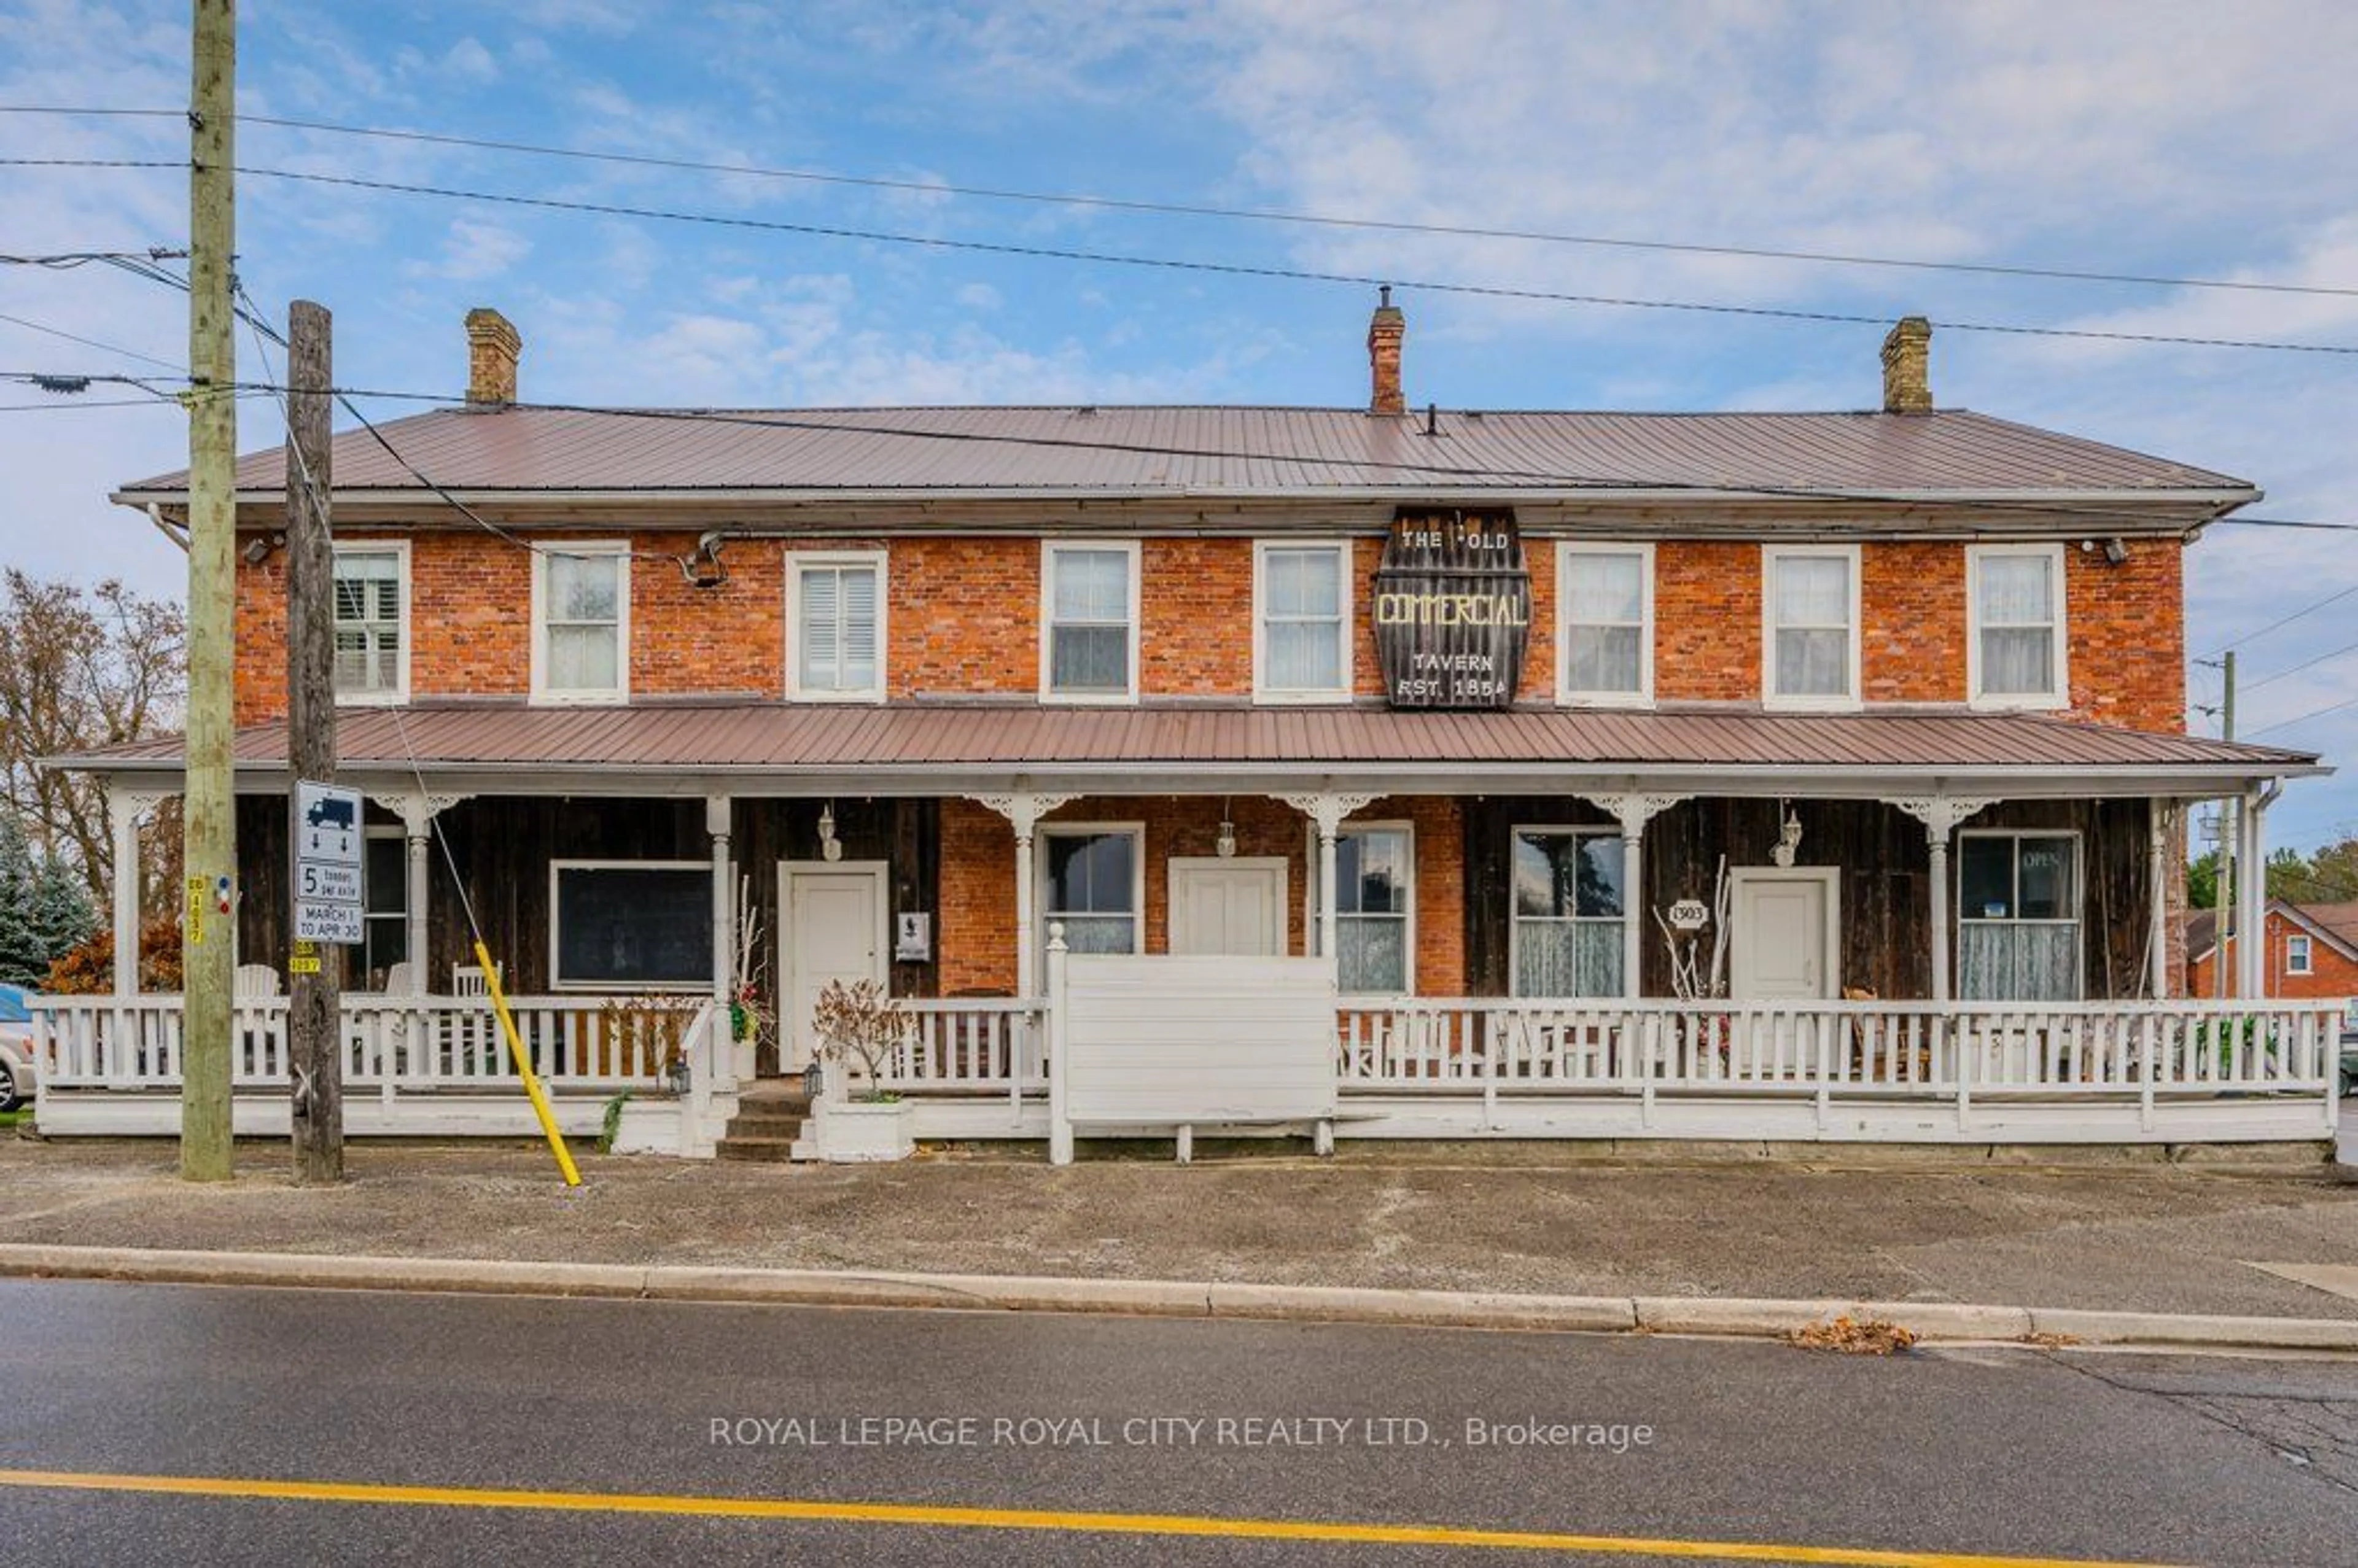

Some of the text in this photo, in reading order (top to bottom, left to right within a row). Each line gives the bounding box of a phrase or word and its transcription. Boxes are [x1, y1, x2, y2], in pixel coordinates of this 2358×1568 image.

[1403, 531, 1508, 549] THE OLD
[1379, 594, 1528, 626] COMMERCIAL
[1414, 654, 1493, 671] TAVERN
[305, 867, 317, 894] 5
[306, 907, 346, 922] MARCH
[301, 922, 360, 937] TO APR 30
